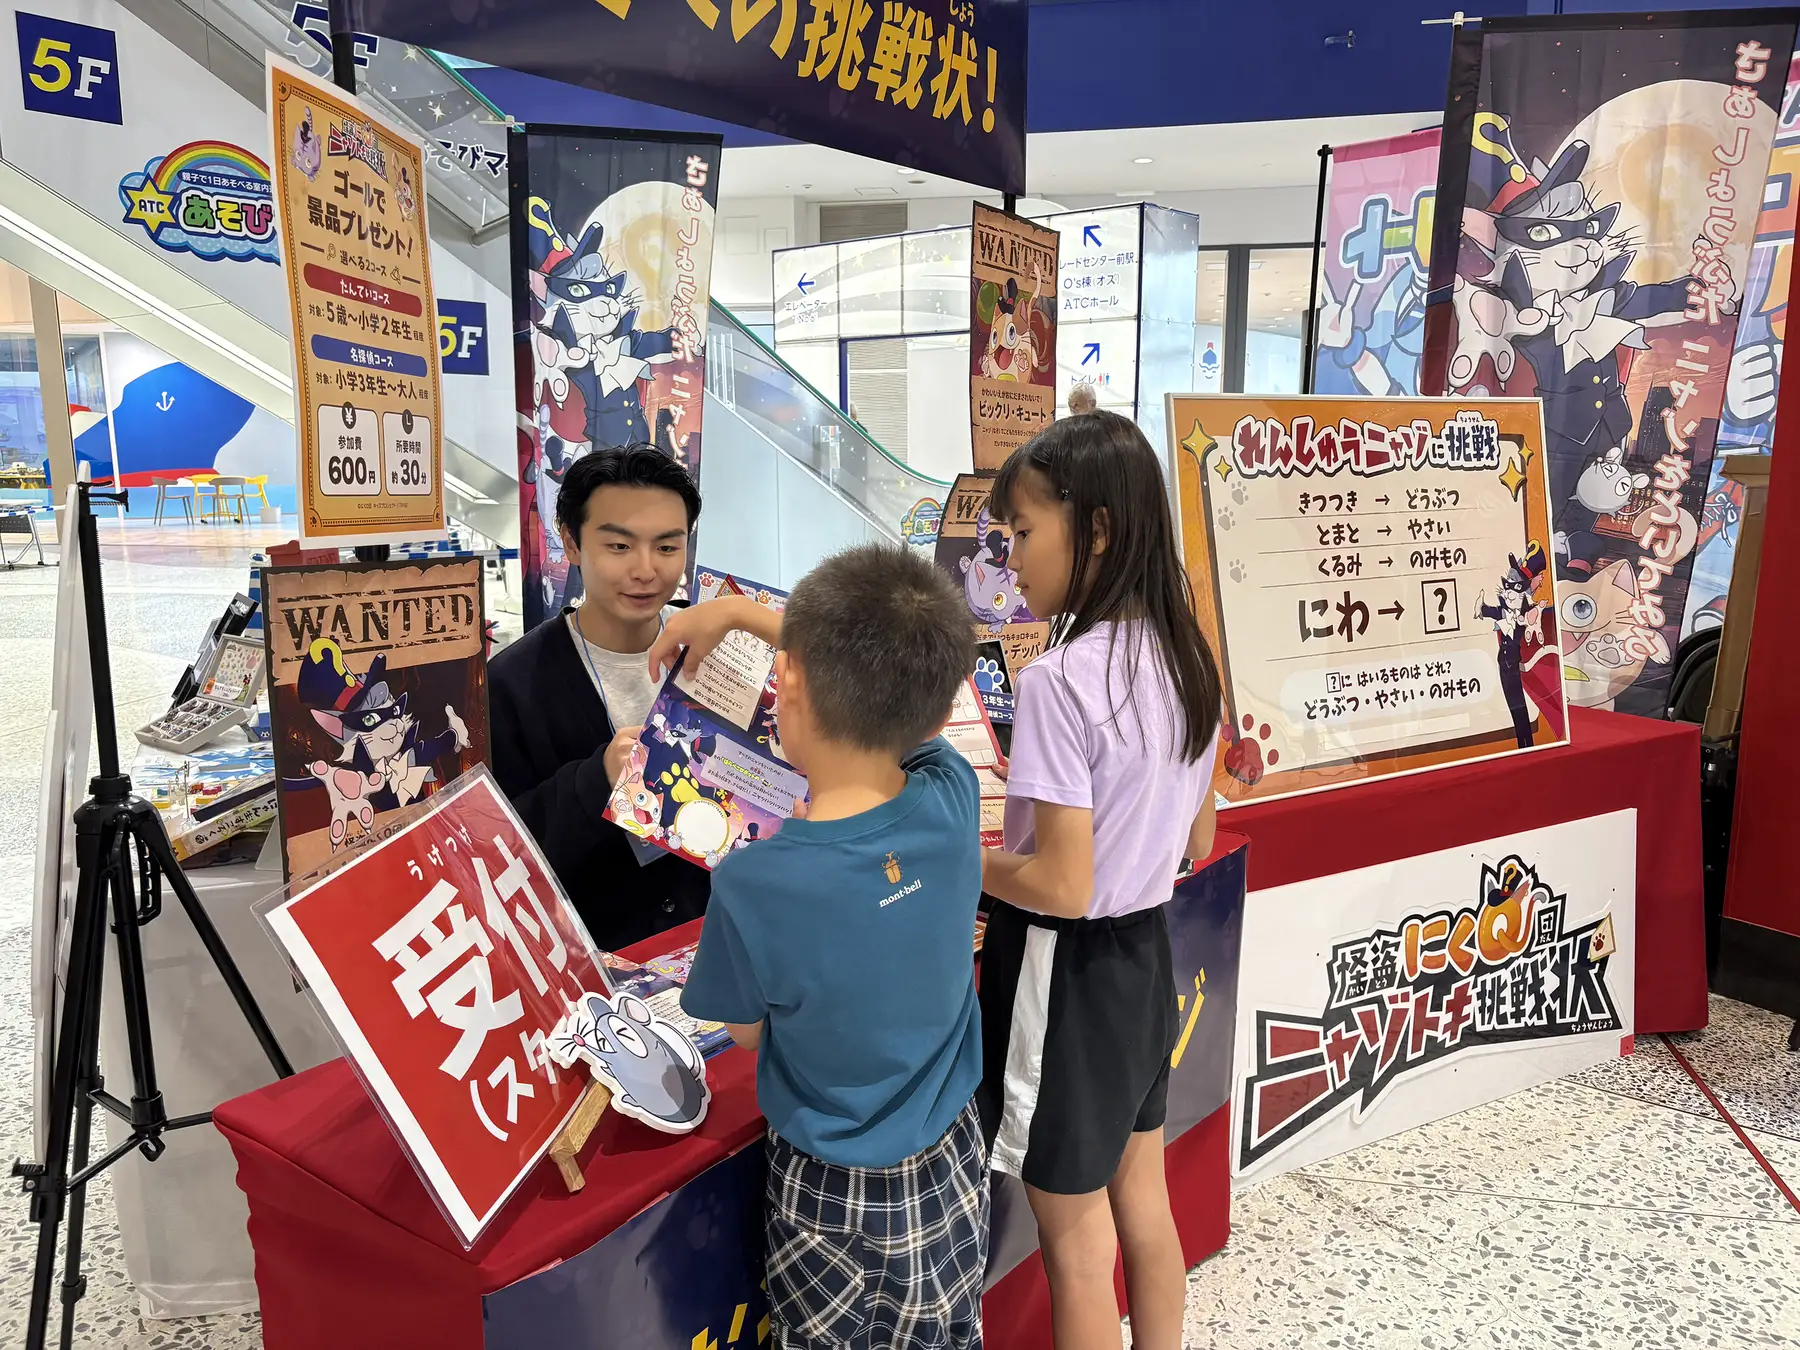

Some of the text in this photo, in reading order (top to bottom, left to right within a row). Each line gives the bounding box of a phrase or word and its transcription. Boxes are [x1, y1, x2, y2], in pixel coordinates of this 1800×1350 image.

[28, 37, 111, 100] 5F
[181, 170, 273, 193] 親子で1日あそべる室内
[334, 169, 387, 215] ゴールで
[138, 199, 165, 214] ATC
[183, 194, 273, 235] あそび
[307, 194, 413, 259] 景品プレゼント!
[340, 250, 388, 277] 選べる2コース
[978, 229, 1054, 277] WANTED
[340, 278, 391, 305] たんていコース
[1064, 295, 1120, 310] ATCホール
[437, 315, 483, 359] 5F
[349, 347, 394, 368] 名探偵コース
[979, 400, 1047, 424] ビックリ・キュート
[337, 435, 421, 455] 参加費 所要時間
[1237, 421, 1498, 470] れんしゅうニャゾに挑戦
[328, 455, 427, 486] 600円 約30分
[1298, 487, 1460, 515] きつつき どうぶつ
[1316, 518, 1451, 546] とまと やさい
[1318, 547, 1467, 577] くるみ のみもの
[280, 593, 474, 651] WANTED
[1298, 587, 1448, 643] にわ ?
[1357, 663, 1421, 687] はいるものは
[1425, 660, 1452, 677] どれ?
[1304, 677, 1481, 720] どうぶつ・やさい・のみもの
[407, 823, 473, 881] うけつけ
[371, 834, 568, 1082] 受付
[1257, 936, 1611, 1139] ニャゾトキ挑戦状
